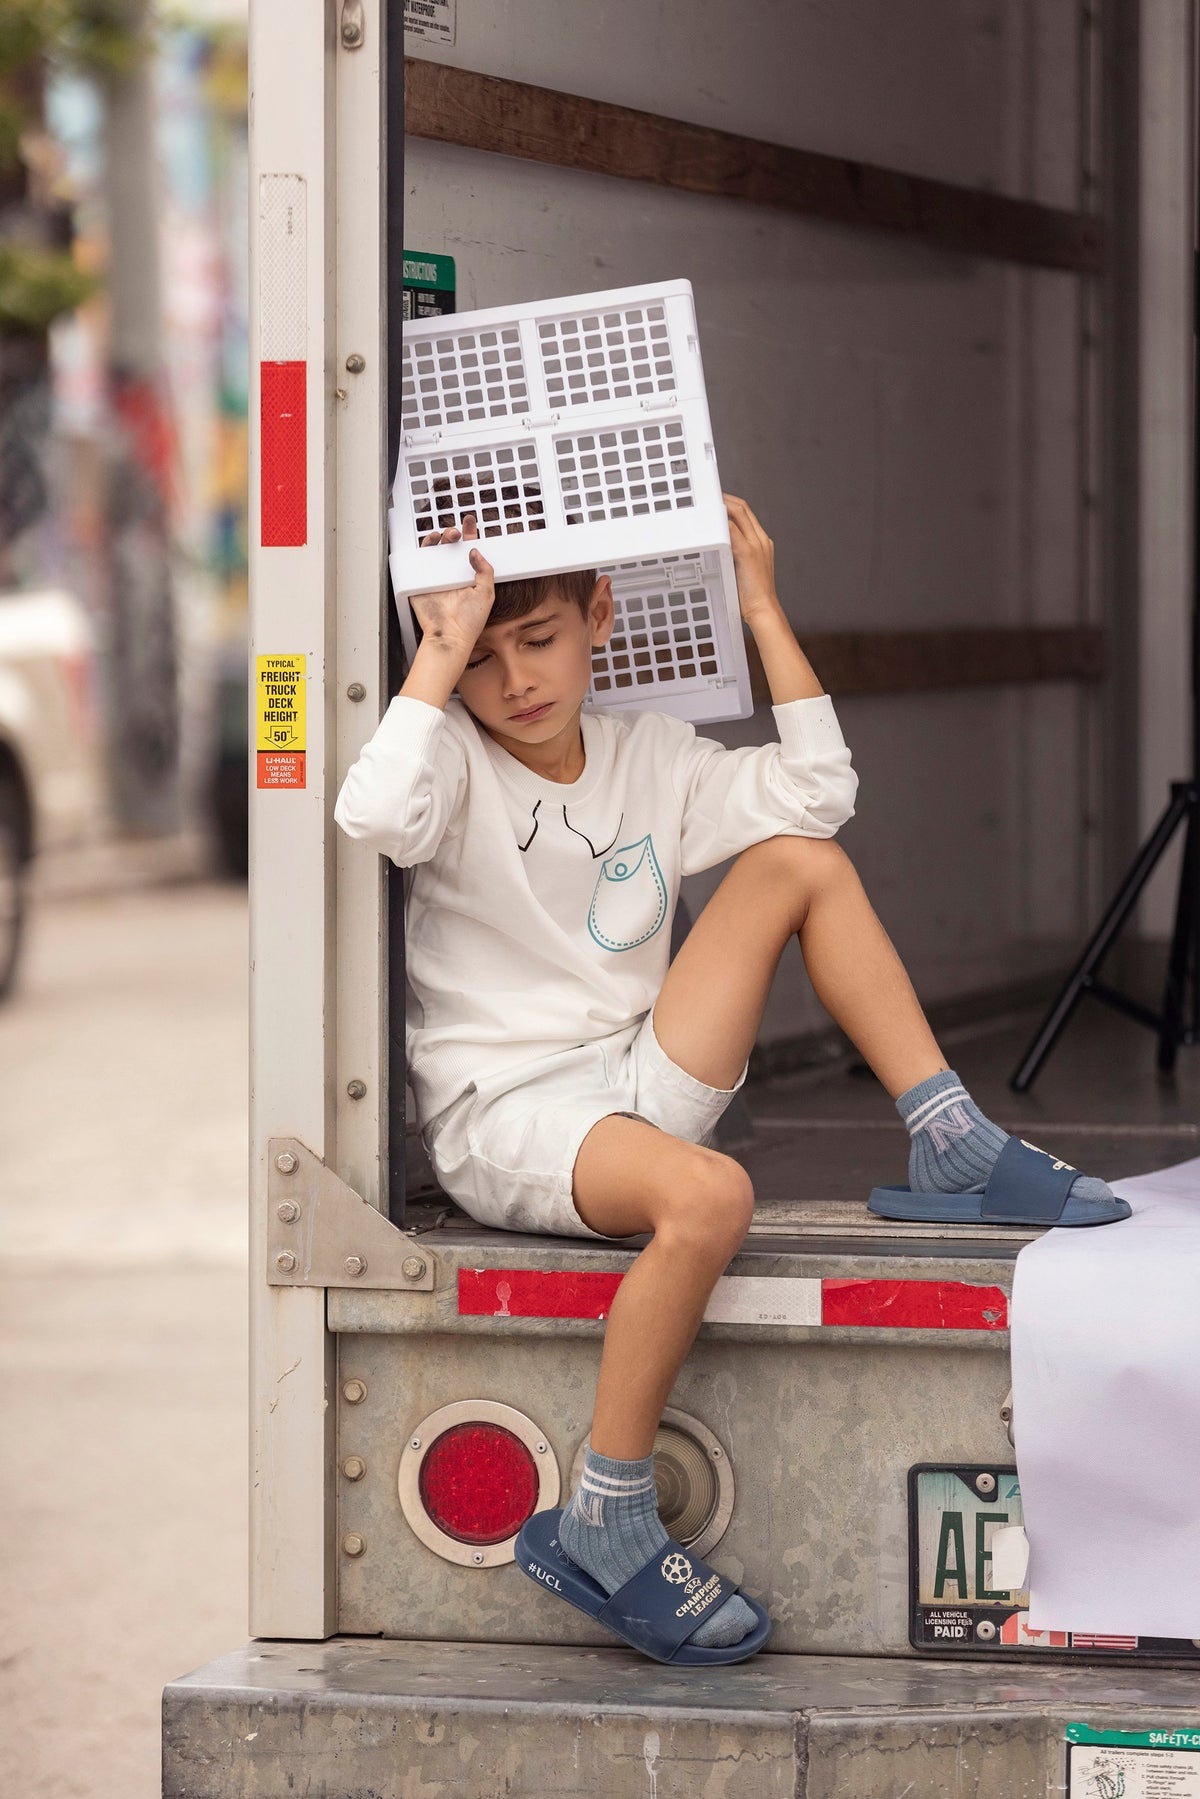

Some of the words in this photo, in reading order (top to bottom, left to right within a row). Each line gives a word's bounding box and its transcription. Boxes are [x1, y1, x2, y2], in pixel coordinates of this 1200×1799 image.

[267, 660, 295, 668] TYPICAL
[261, 671, 301, 682] FREIGHT
[265, 684, 296, 695] TRUCK
[268, 697, 293, 708] DECK
[264, 711, 298, 722] HEIGHT
[528, 1562, 562, 1592] #UCL
[685, 1578, 702, 1594] UEFA
[675, 1574, 720, 1618] CHAMPIONS
[957, 1618, 973, 1626] FEES
[934, 1626, 964, 1638] PAID
